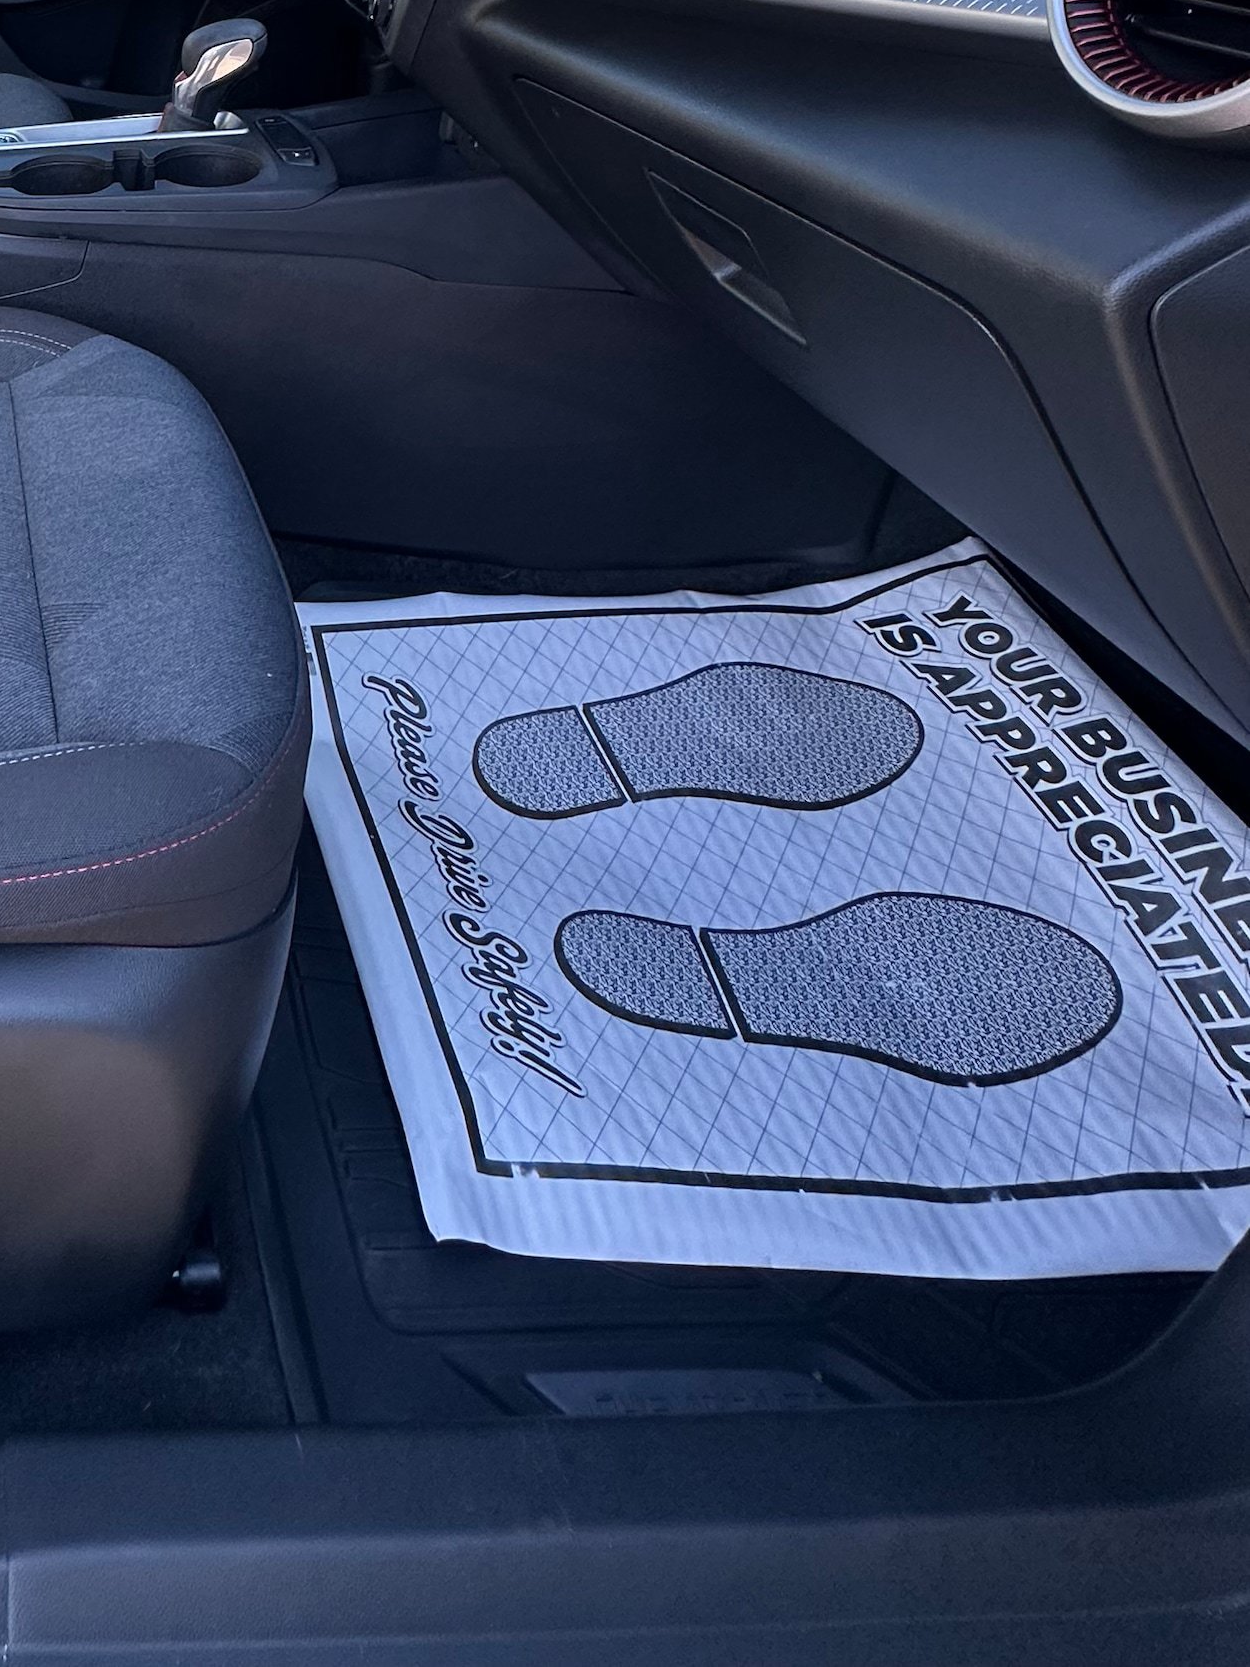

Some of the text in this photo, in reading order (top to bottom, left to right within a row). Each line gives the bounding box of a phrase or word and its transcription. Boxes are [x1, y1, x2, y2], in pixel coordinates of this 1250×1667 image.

[935, 595, 1083, 715] YOUR
[366, 674, 583, 1091] Please Drive Safely!
[860, 613, 1250, 1117] IS APPRECIATED
